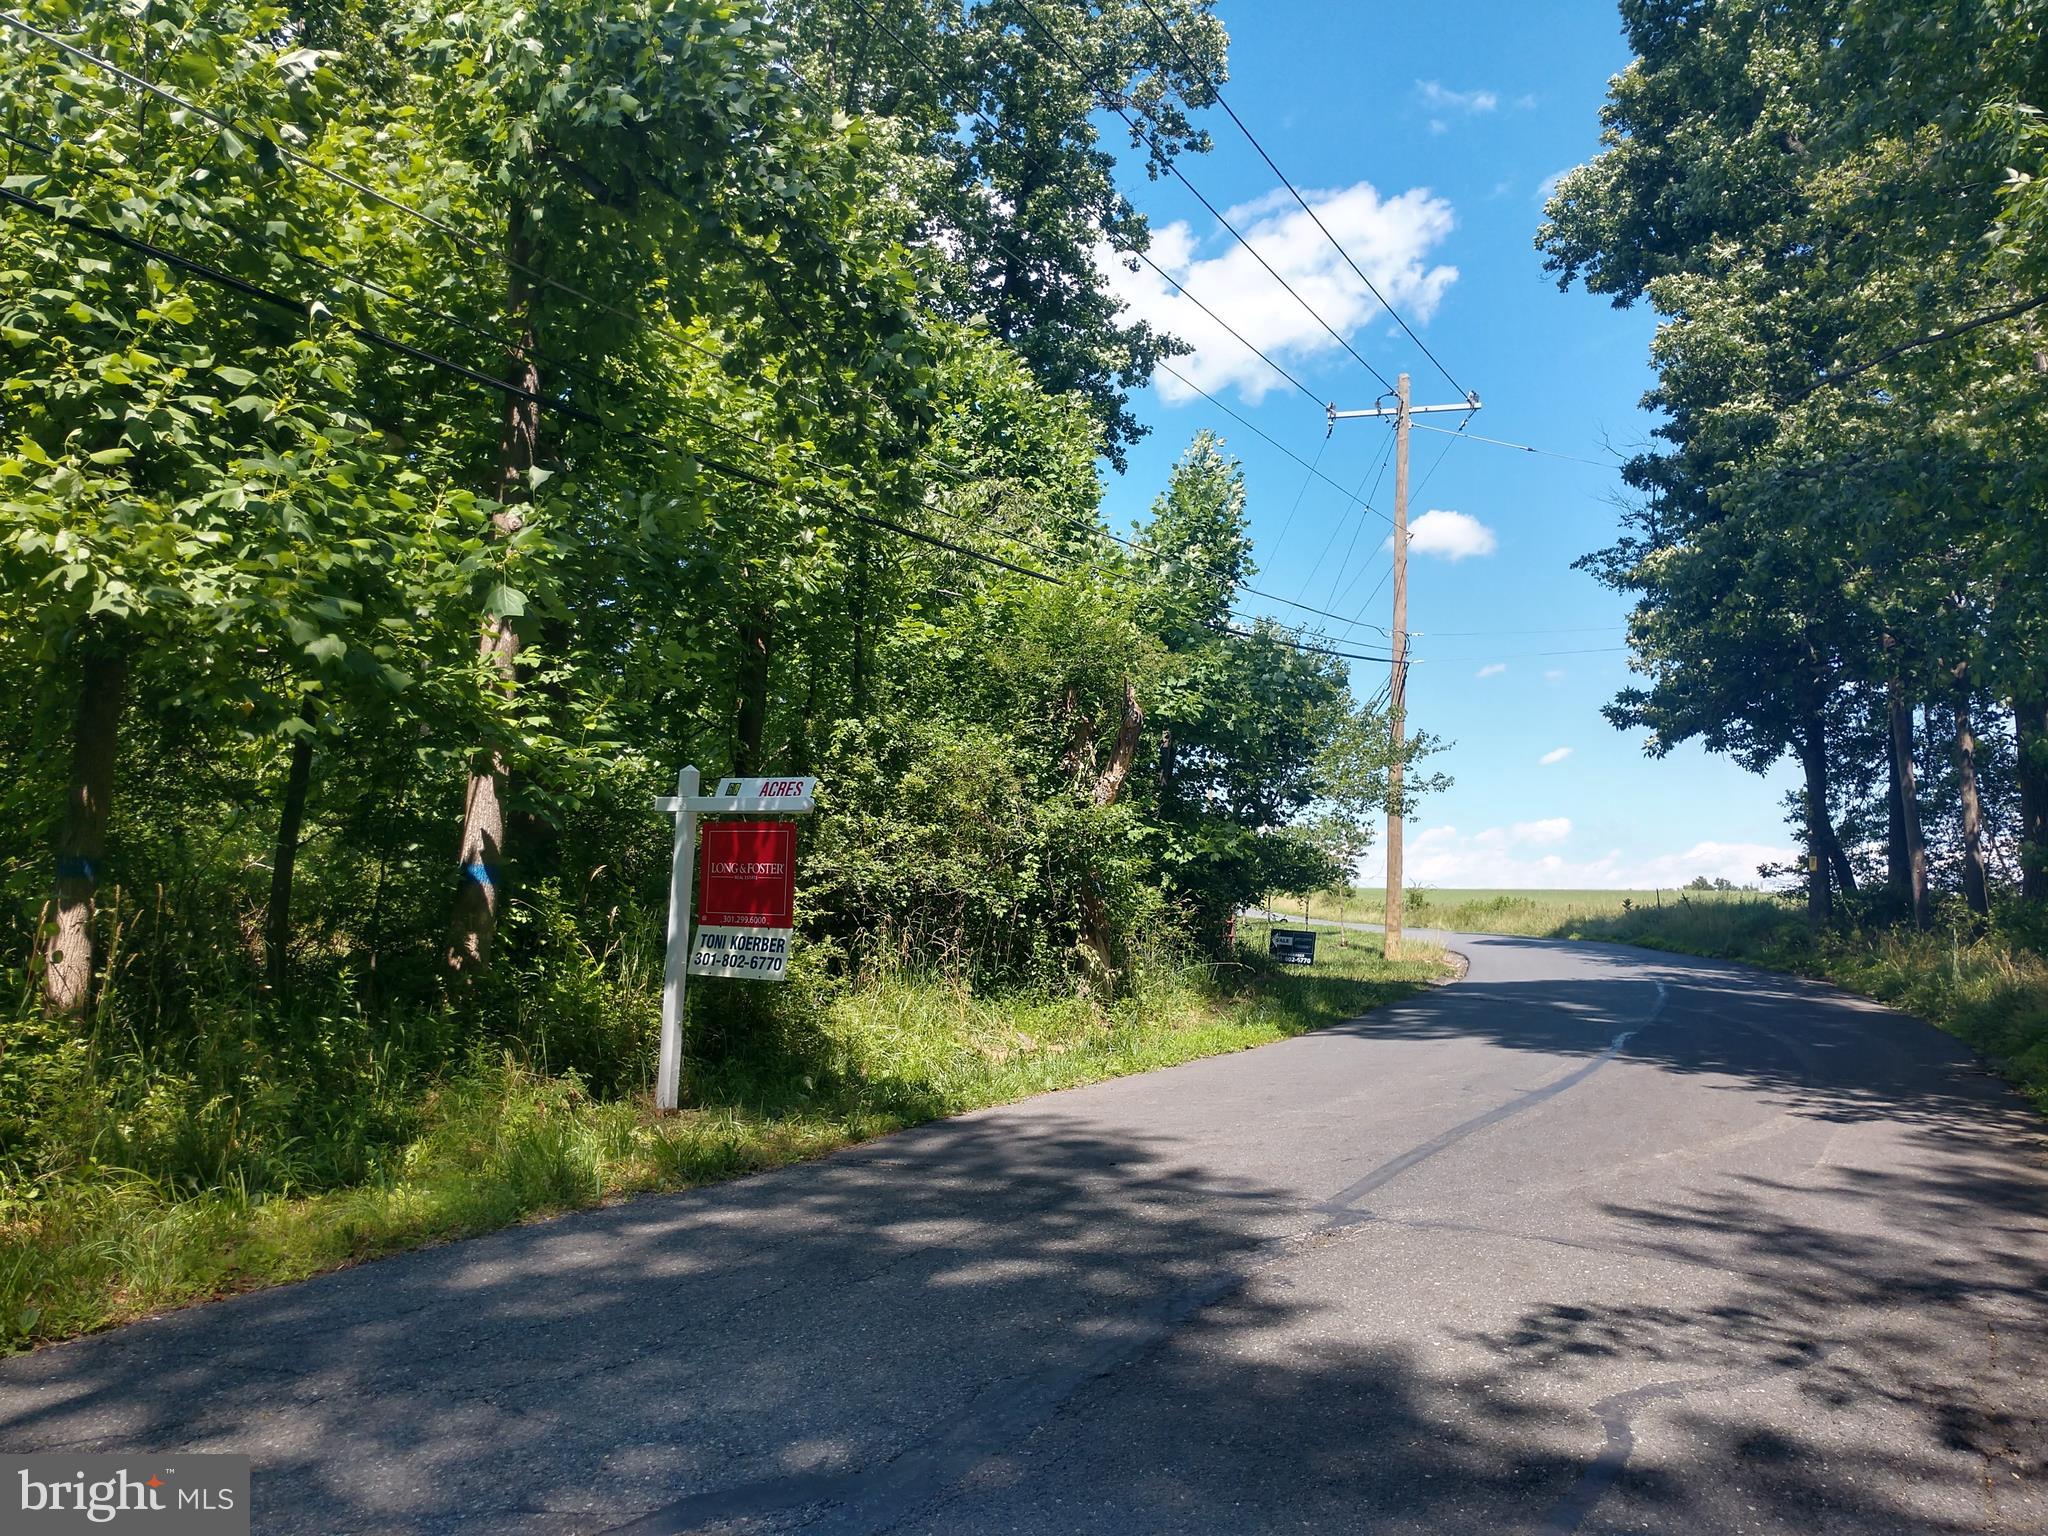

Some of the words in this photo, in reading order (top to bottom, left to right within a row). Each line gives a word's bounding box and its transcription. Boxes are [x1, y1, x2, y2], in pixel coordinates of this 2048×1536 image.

[759, 781, 804, 797] ACRES
[722, 915, 767, 924] 301.299.6000
[700, 933, 727, 949] TONI
[729, 935, 786, 953] KOERBER
[694, 952, 782, 971] 301-802-6770
